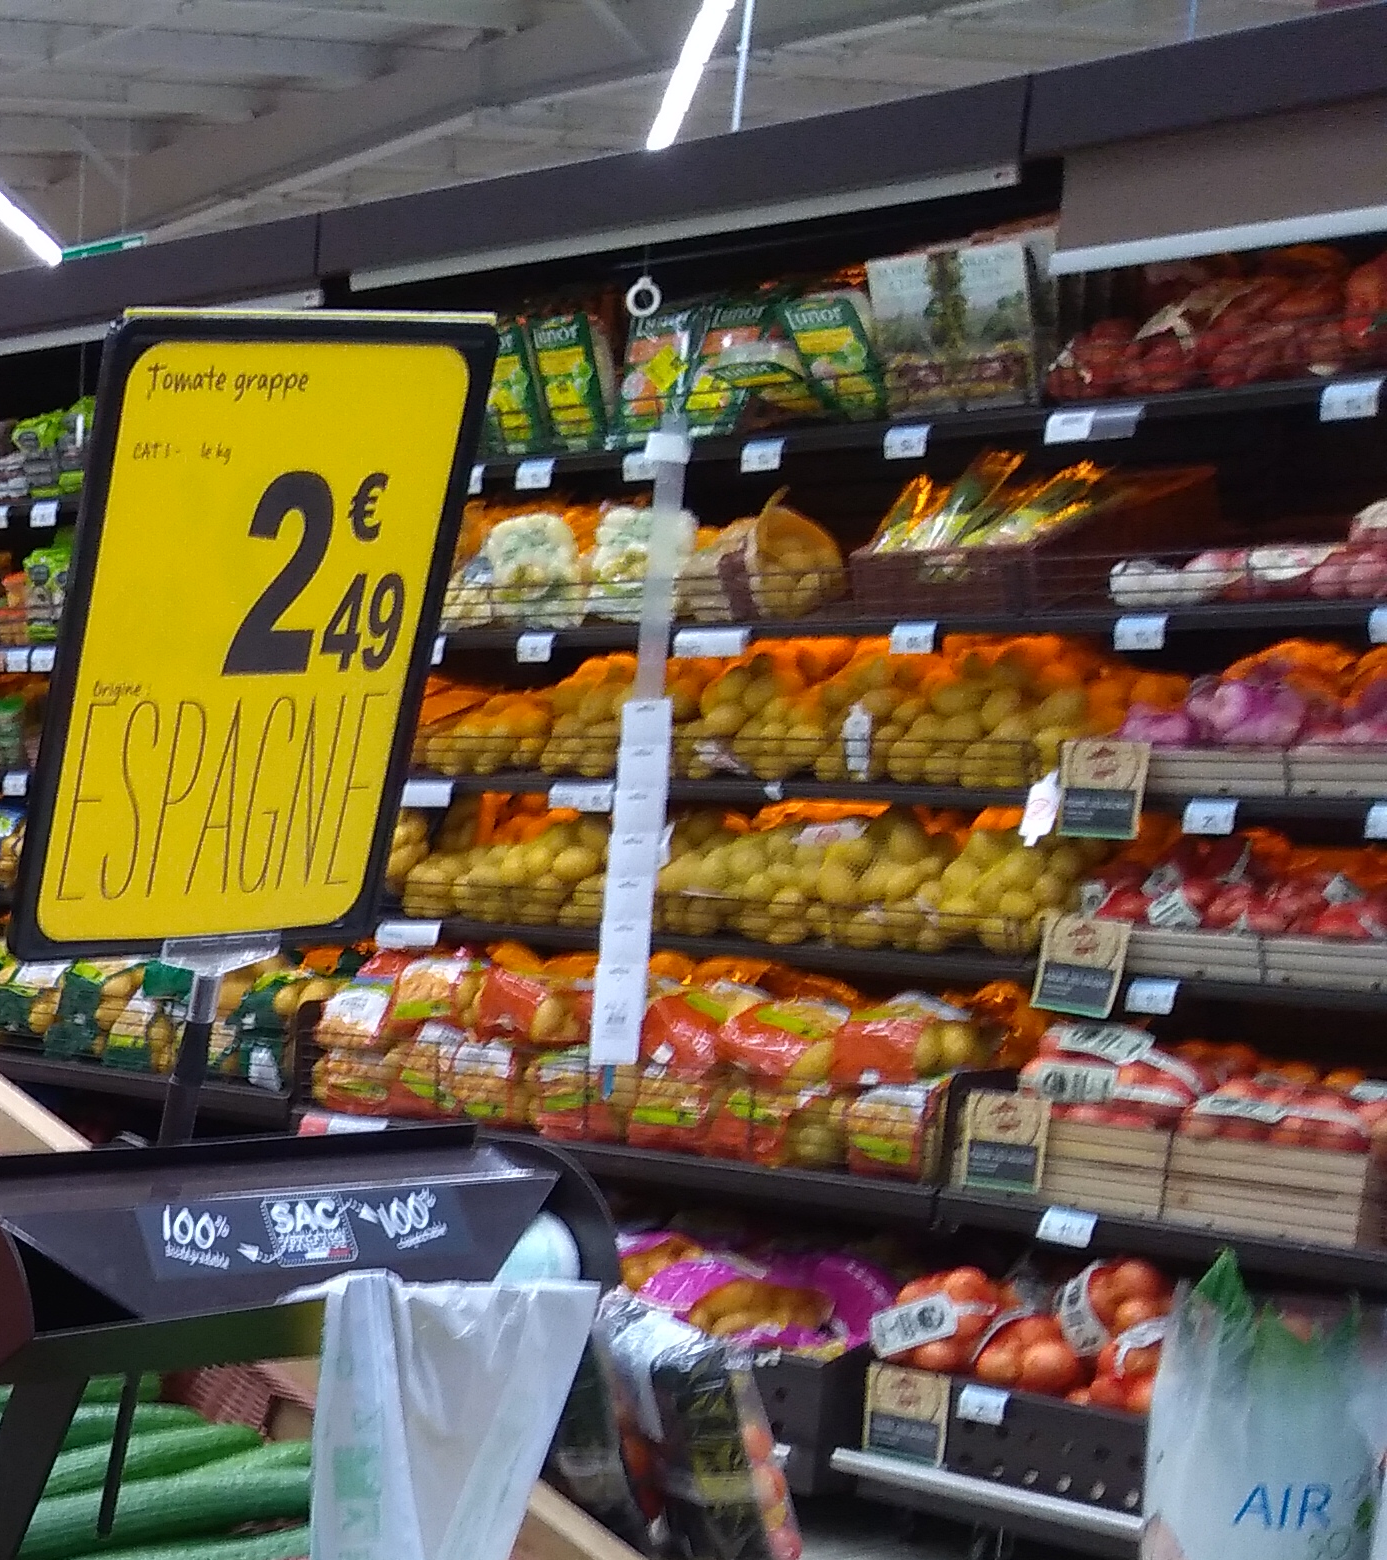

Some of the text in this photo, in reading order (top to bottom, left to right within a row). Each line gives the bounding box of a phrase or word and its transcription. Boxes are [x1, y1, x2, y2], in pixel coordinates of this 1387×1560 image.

[147, 362, 309, 401] Tomate grappe
[222, 470, 390, 677] 2 €
[319, 573, 406, 673] 49
[55, 688, 390, 901] ESPAGNE
[270, 1198, 341, 1235] SAC
[1232, 1483, 1332, 1530] AIR
